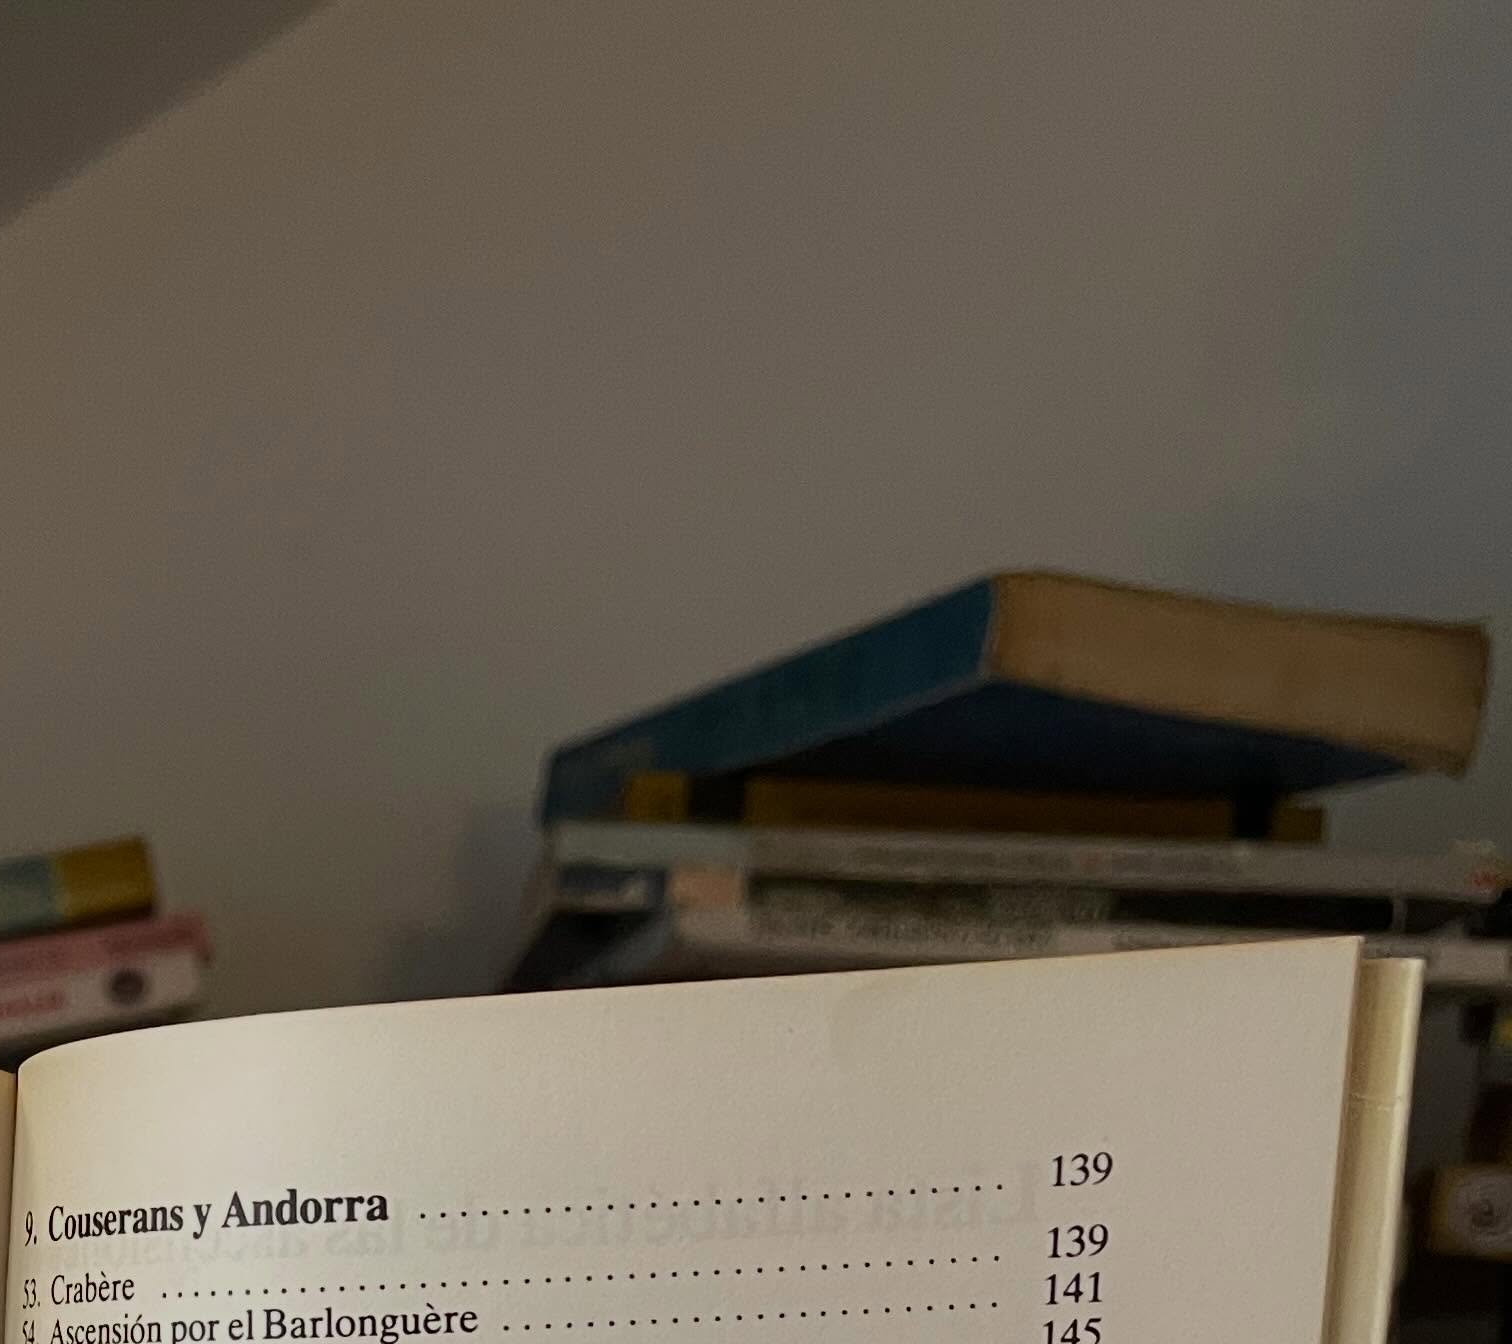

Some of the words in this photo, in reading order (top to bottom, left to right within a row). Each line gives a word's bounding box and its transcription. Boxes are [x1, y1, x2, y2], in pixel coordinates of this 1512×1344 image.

[24, 1210, 38, 1247] 9.
[48, 1205, 184, 1242] Couserans
[192, 1203, 213, 1240] y
[220, 1188, 390, 1229] Andorra
[1052, 1151, 1114, 1188] 139
[22, 1277, 41, 1310] 53.
[50, 1270, 135, 1306] Crabère
[1047, 1223, 1109, 1259] 139
[228, 1309, 255, 1341] el
[1045, 1271, 1103, 1306] 141
